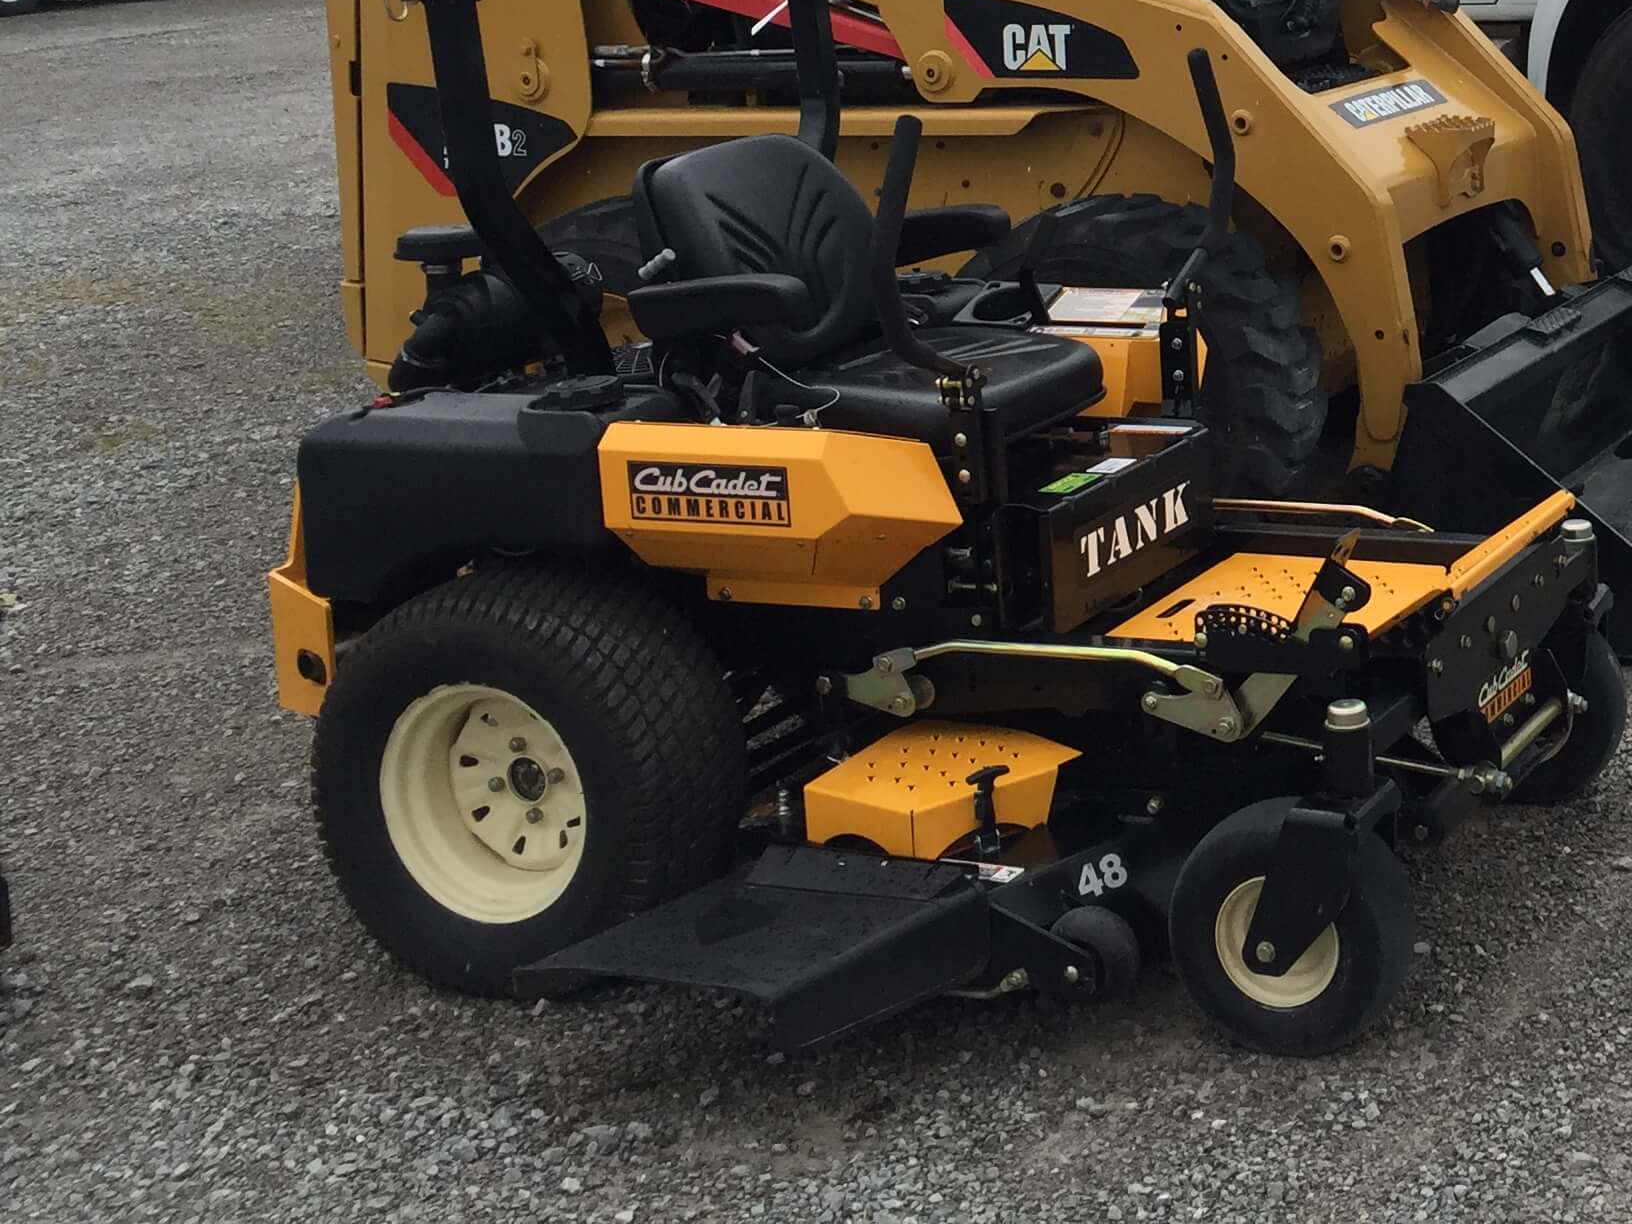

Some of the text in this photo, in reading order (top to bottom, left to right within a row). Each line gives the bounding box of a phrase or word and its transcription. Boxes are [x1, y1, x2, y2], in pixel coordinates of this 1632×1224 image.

[1003, 23, 1067, 71] CAT
[1343, 84, 1435, 121] CATERPILLAR
[634, 467, 782, 497] Cub Cadet
[635, 495, 785, 521] COMMERCIAL
[1080, 481, 1189, 577] TANK
[1078, 853, 1128, 897] 48
